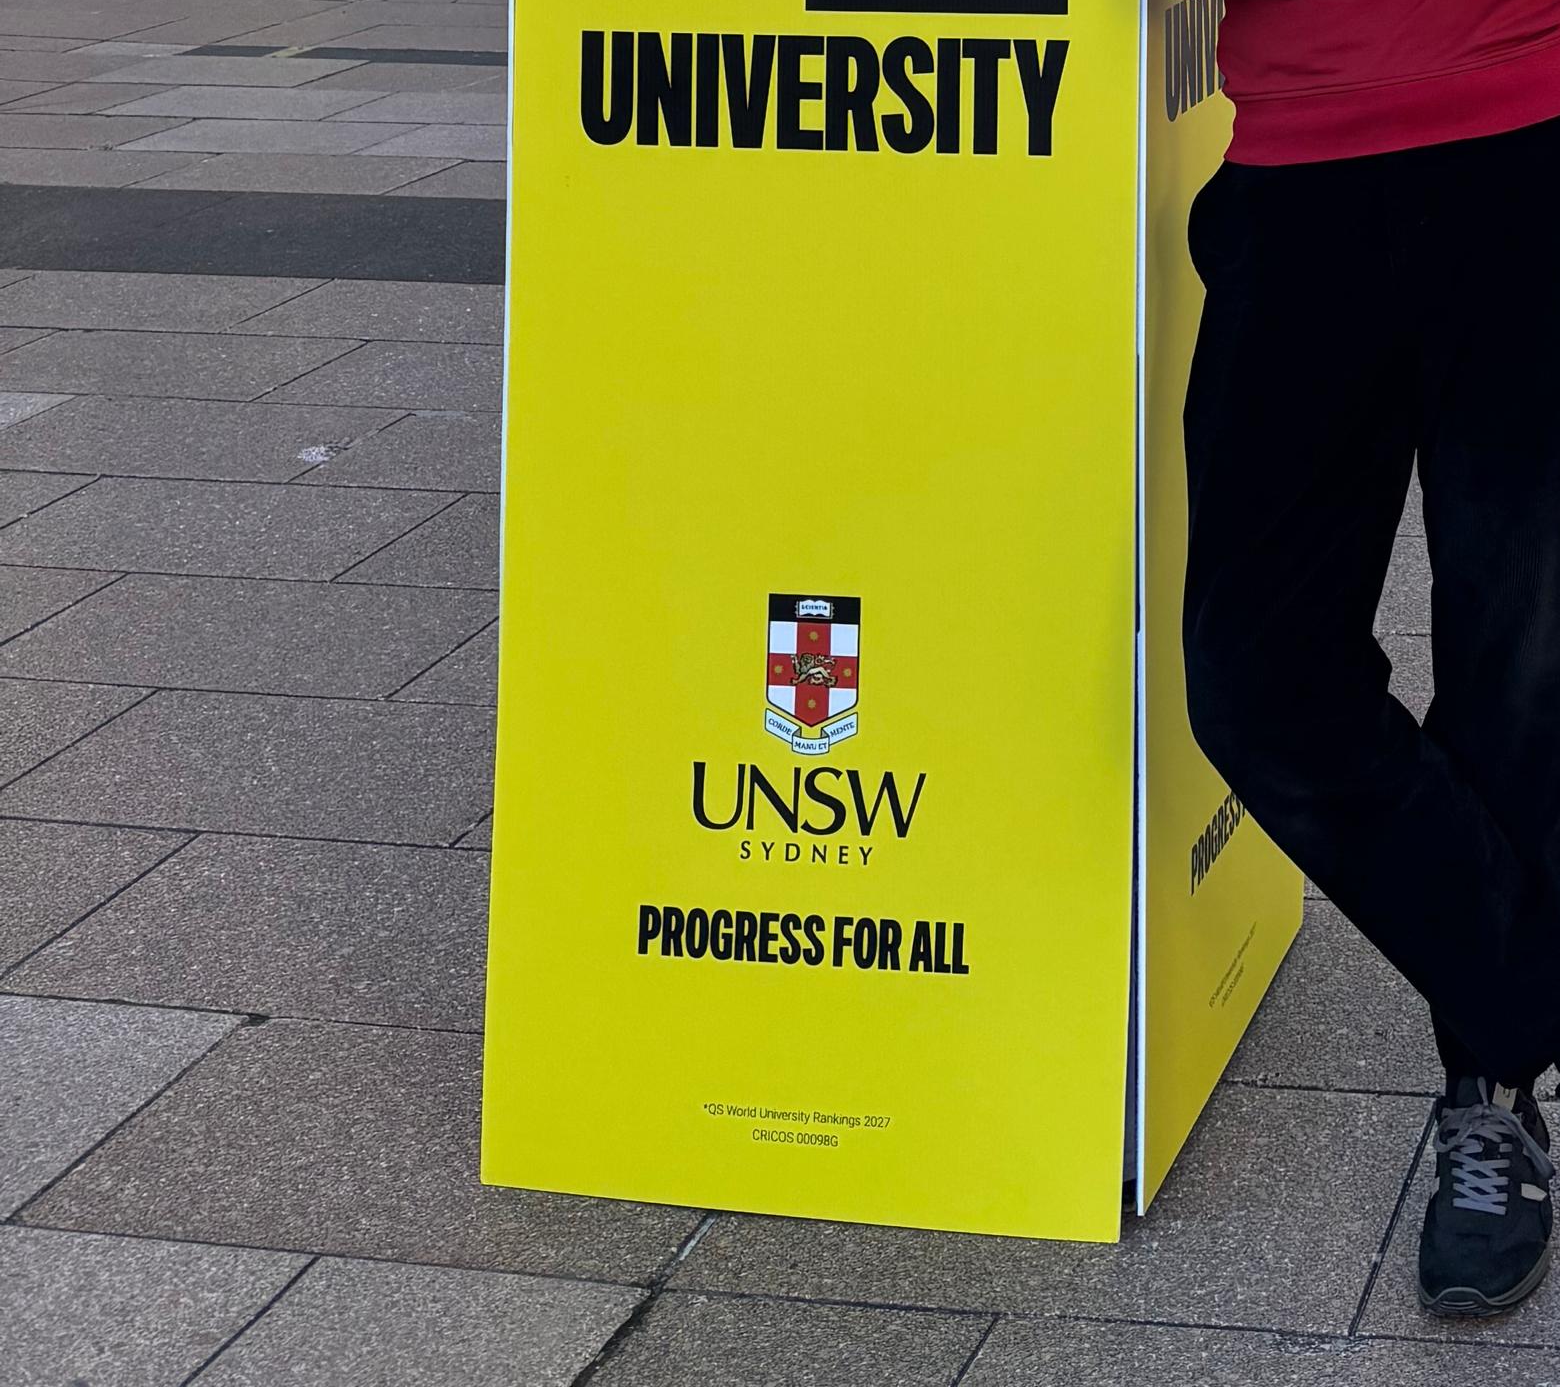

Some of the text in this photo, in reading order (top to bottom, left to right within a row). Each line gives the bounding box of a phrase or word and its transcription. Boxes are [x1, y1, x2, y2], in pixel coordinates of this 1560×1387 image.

[580, 30, 1071, 157] UNIVERSITY
[801, 604, 828, 612] SCIENTIA
[768, 718, 793, 735] CORDE
[794, 741, 817, 751] MANU
[830, 721, 855, 738] MENTE
[692, 761, 927, 838] UNSW
[740, 840, 873, 866] SYDNEY
[637, 904, 970, 975] PROGRESS FOR ALL
[726, 1105, 757, 1118] World
[759, 1108, 811, 1125] University
[813, 1111, 861, 1129] Rankings
[864, 1115, 892, 1128] 2027
[752, 1128, 839, 1147] CRICOS 00098G
